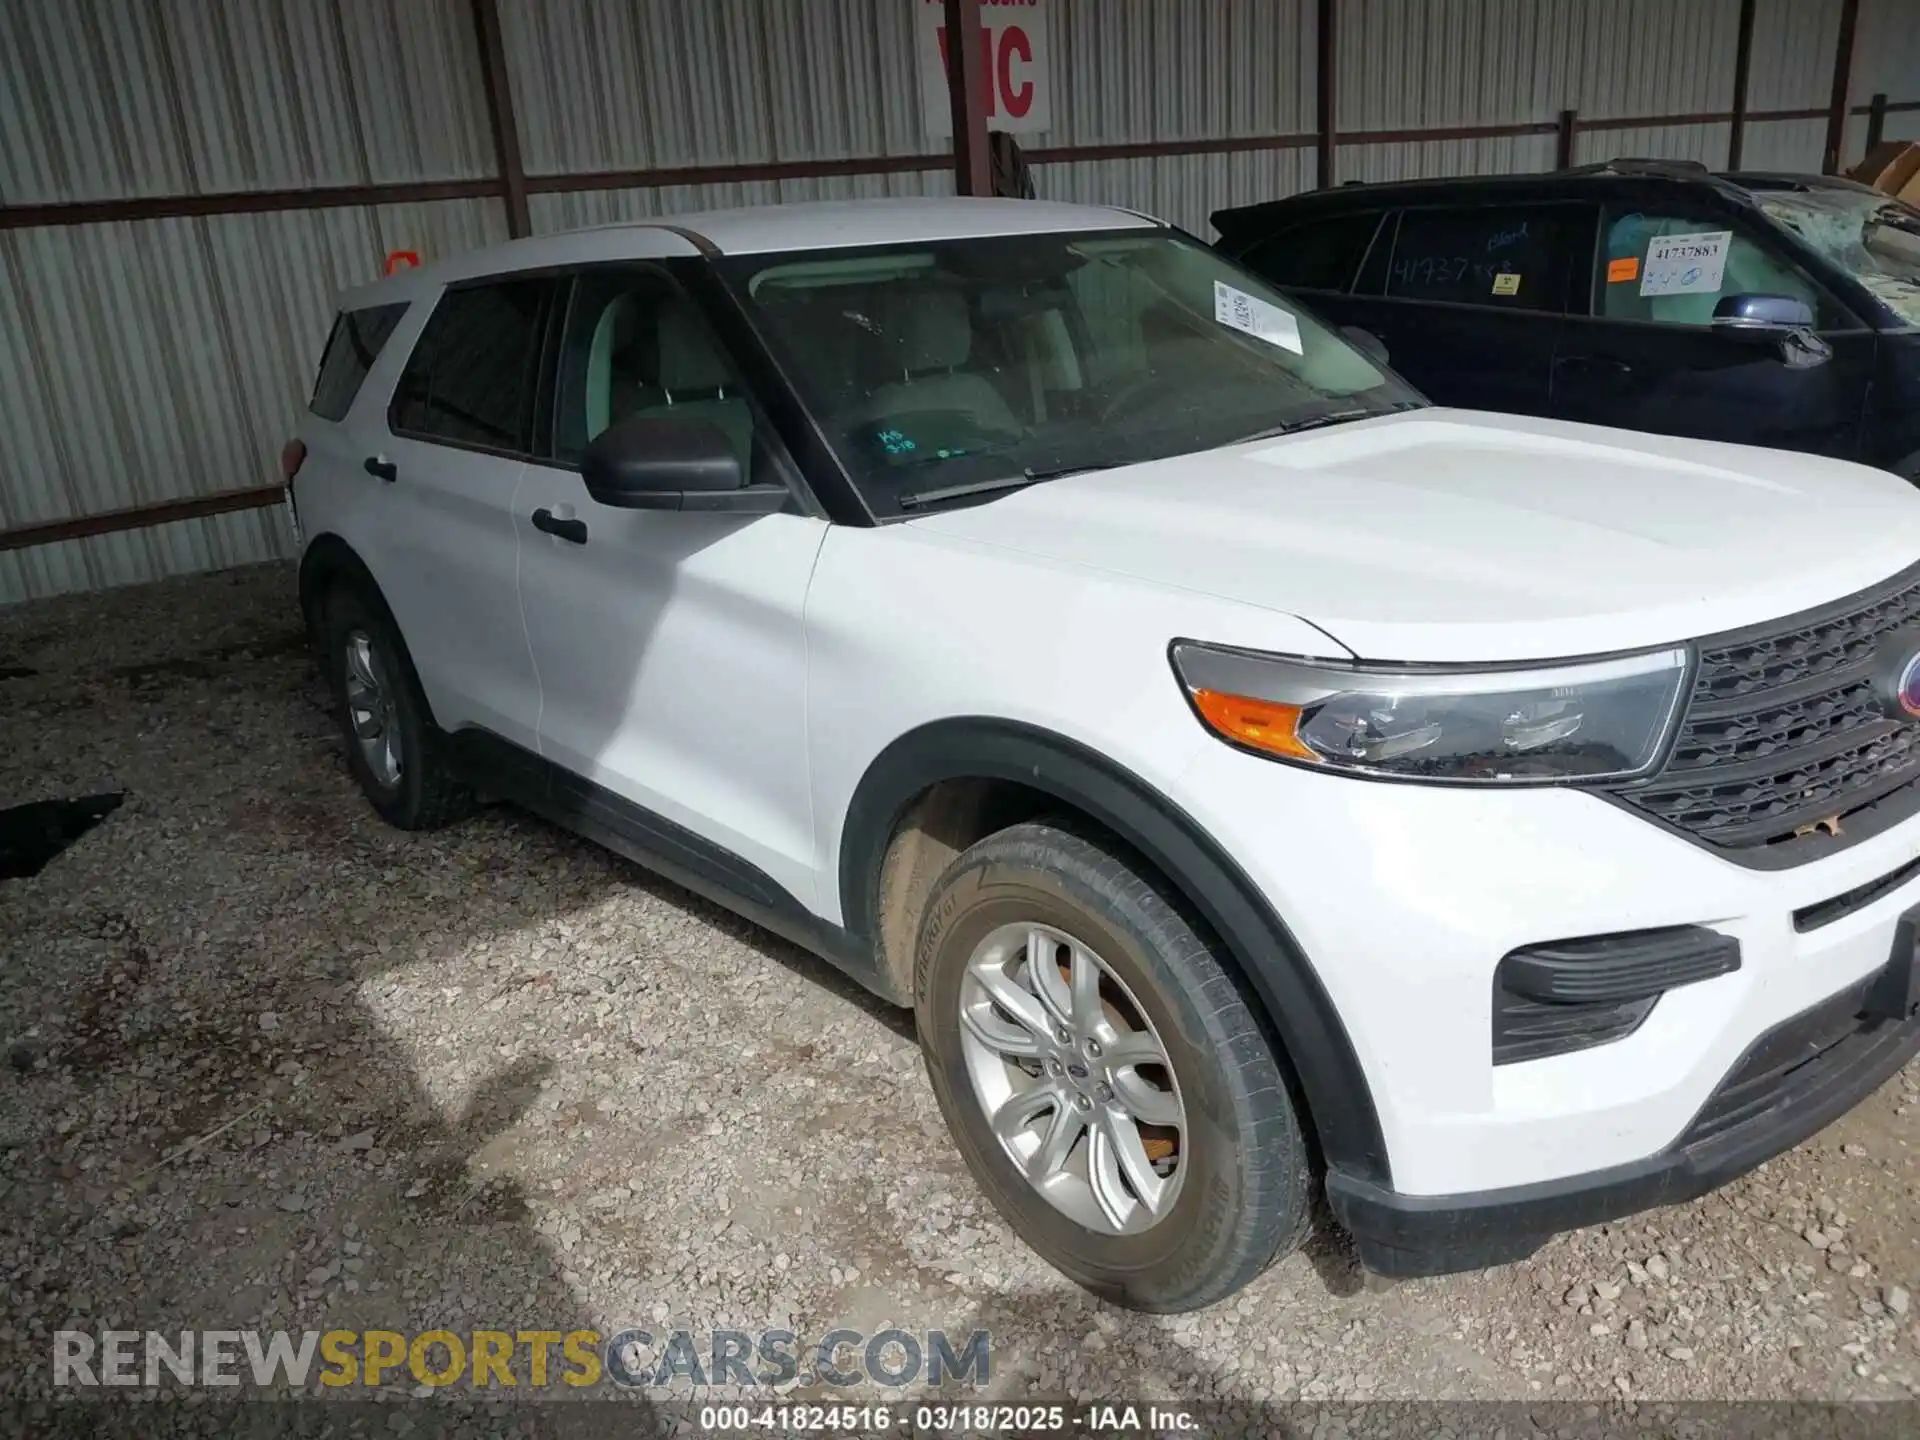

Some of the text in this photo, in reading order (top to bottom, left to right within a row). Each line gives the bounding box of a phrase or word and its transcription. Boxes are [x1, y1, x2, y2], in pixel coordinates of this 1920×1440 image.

[936, 26, 1033, 118] IC
[1656, 244, 1719, 260] 41737883
[1394, 256, 1513, 286] 41737
